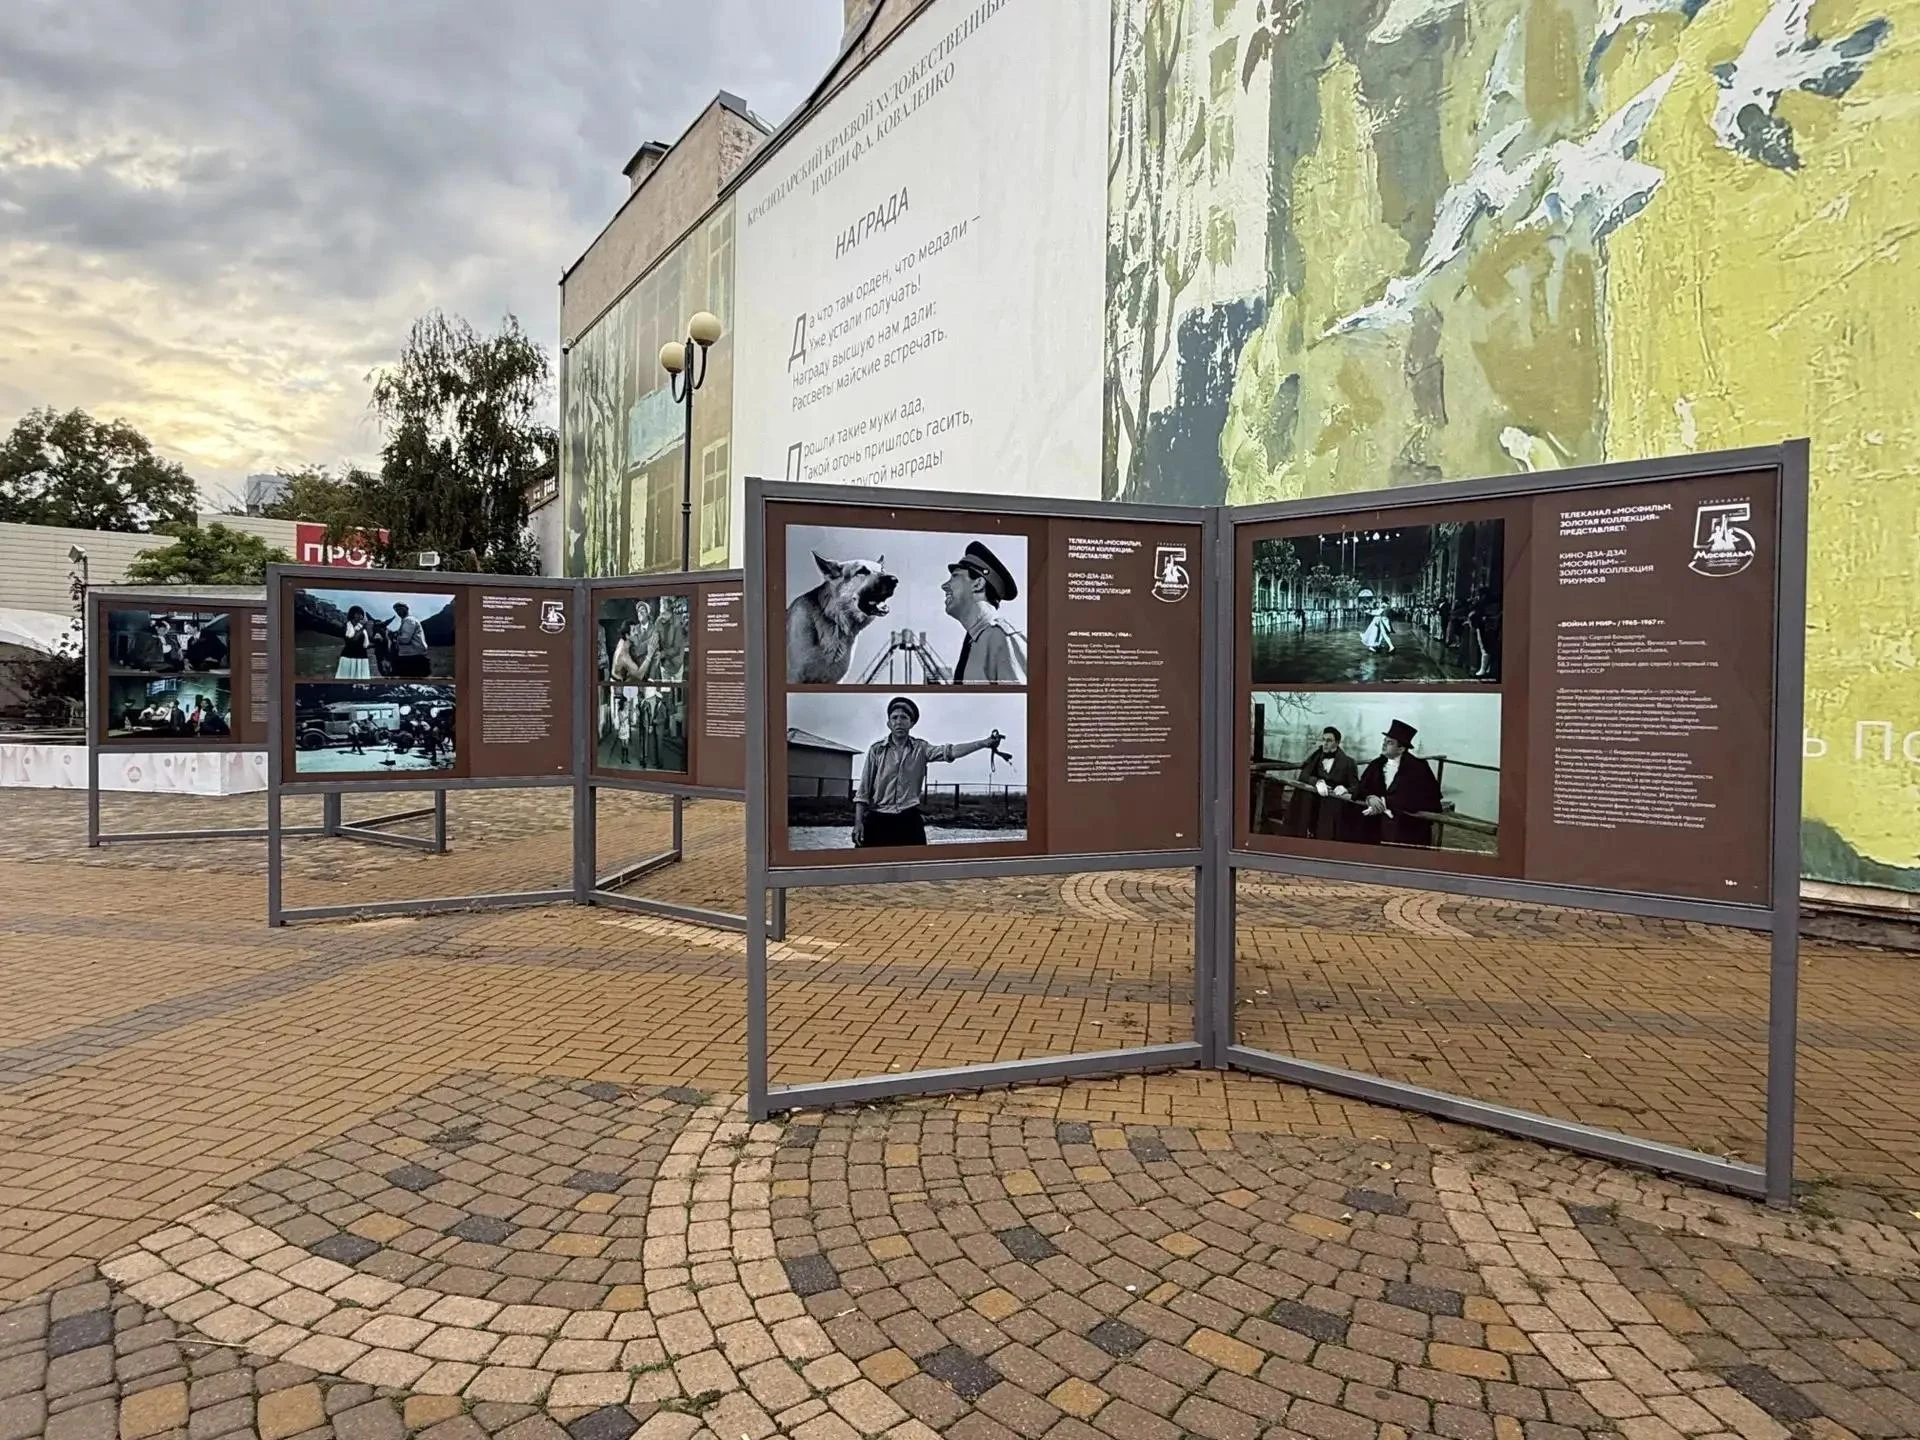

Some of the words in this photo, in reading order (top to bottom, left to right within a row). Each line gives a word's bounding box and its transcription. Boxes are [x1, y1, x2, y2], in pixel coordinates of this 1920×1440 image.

[747, 144, 823, 228] КРАСНОДАРСКИЙ
[825, 100, 874, 161] КРАЕВОЙ
[876, 0, 1010, 115] ХУДОЖЕСТВЕННЫ
[812, 150, 850, 195] ИМЕНИ
[876, 62, 955, 142] КОВАЛЕНКО
[836, 186, 910, 260] НАГРАДА
[817, 304, 834, 321] что
[836, 292, 854, 313] там
[856, 268, 892, 300] орден,
[895, 253, 915, 275] что
[918, 220, 968, 260] медали
[809, 333, 827, 353] Уже
[828, 312, 862, 347] устали
[865, 273, 921, 320] получать!
[793, 360, 830, 388] Награду
[832, 335, 874, 368] высшую
[878, 320, 900, 344] нам
[903, 301, 937, 333] дали:
[792, 381, 834, 412] Рассветы
[837, 357, 881, 392] майские
[884, 327, 948, 368] встречать.
[837, 420, 867, 444] такие
[869, 407, 897, 433] муки
[900, 397, 925, 420] ада,
[804, 458, 830, 481] Такой
[833, 449, 862, 471] огонь
[864, 426, 922, 462] пришлось
[926, 410, 974, 437] гасить,
[891, 450, 943, 479] награды
[1560, 508, 1611, 519] ТЕЛЕКАНАЛ
[1560, 518, 1599, 527] ЗОЛОТАЯ
[1600, 514, 1660, 524] КОЛЛЕКЦИЯ»
[1560, 525, 1628, 536] ПРЕДСТАВЛЯЕТ:
[1559, 549, 1628, 559] КИНО-ДЗА-ДЗА!
[1559, 559, 1619, 568] «МОСФИЛЬМ»
[1559, 568, 1599, 577] ЗОЛОТАЯ
[1600, 565, 1654, 574] КОЛЛЕКЦИЯ
[1559, 576, 1606, 585] ТРИУМФОВ
